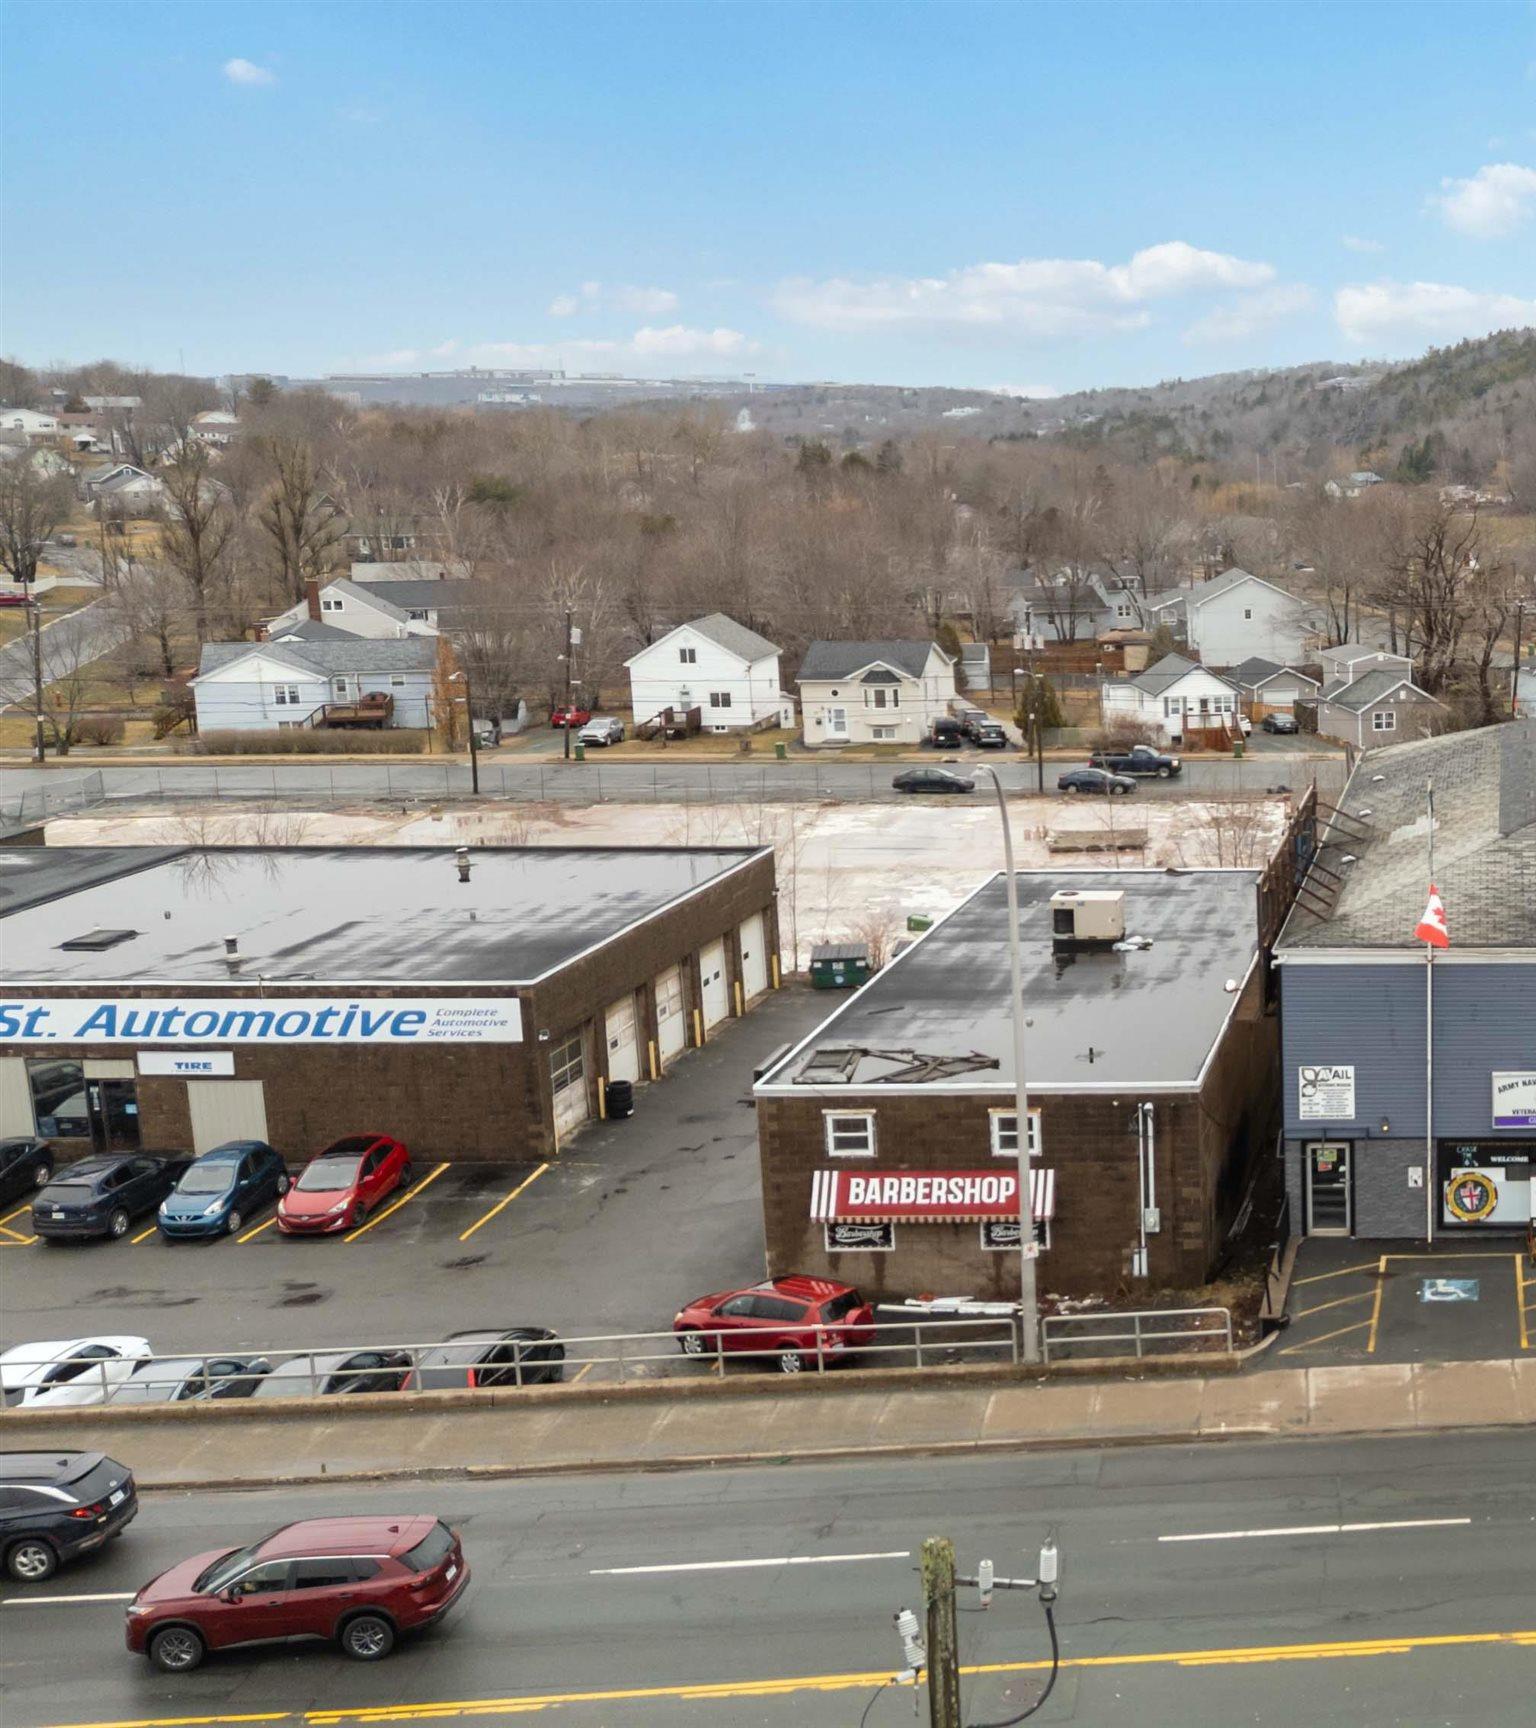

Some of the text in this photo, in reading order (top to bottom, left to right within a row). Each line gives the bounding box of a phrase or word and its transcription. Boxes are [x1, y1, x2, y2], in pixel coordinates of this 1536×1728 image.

[436, 1008, 498, 1017] Complete
[0, 1004, 427, 1037] St. Automotive
[432, 1019, 508, 1027] Automotive
[1498, 1081, 1519, 1093] ARMY
[848, 1176, 1016, 1205] BARBERSHOP
